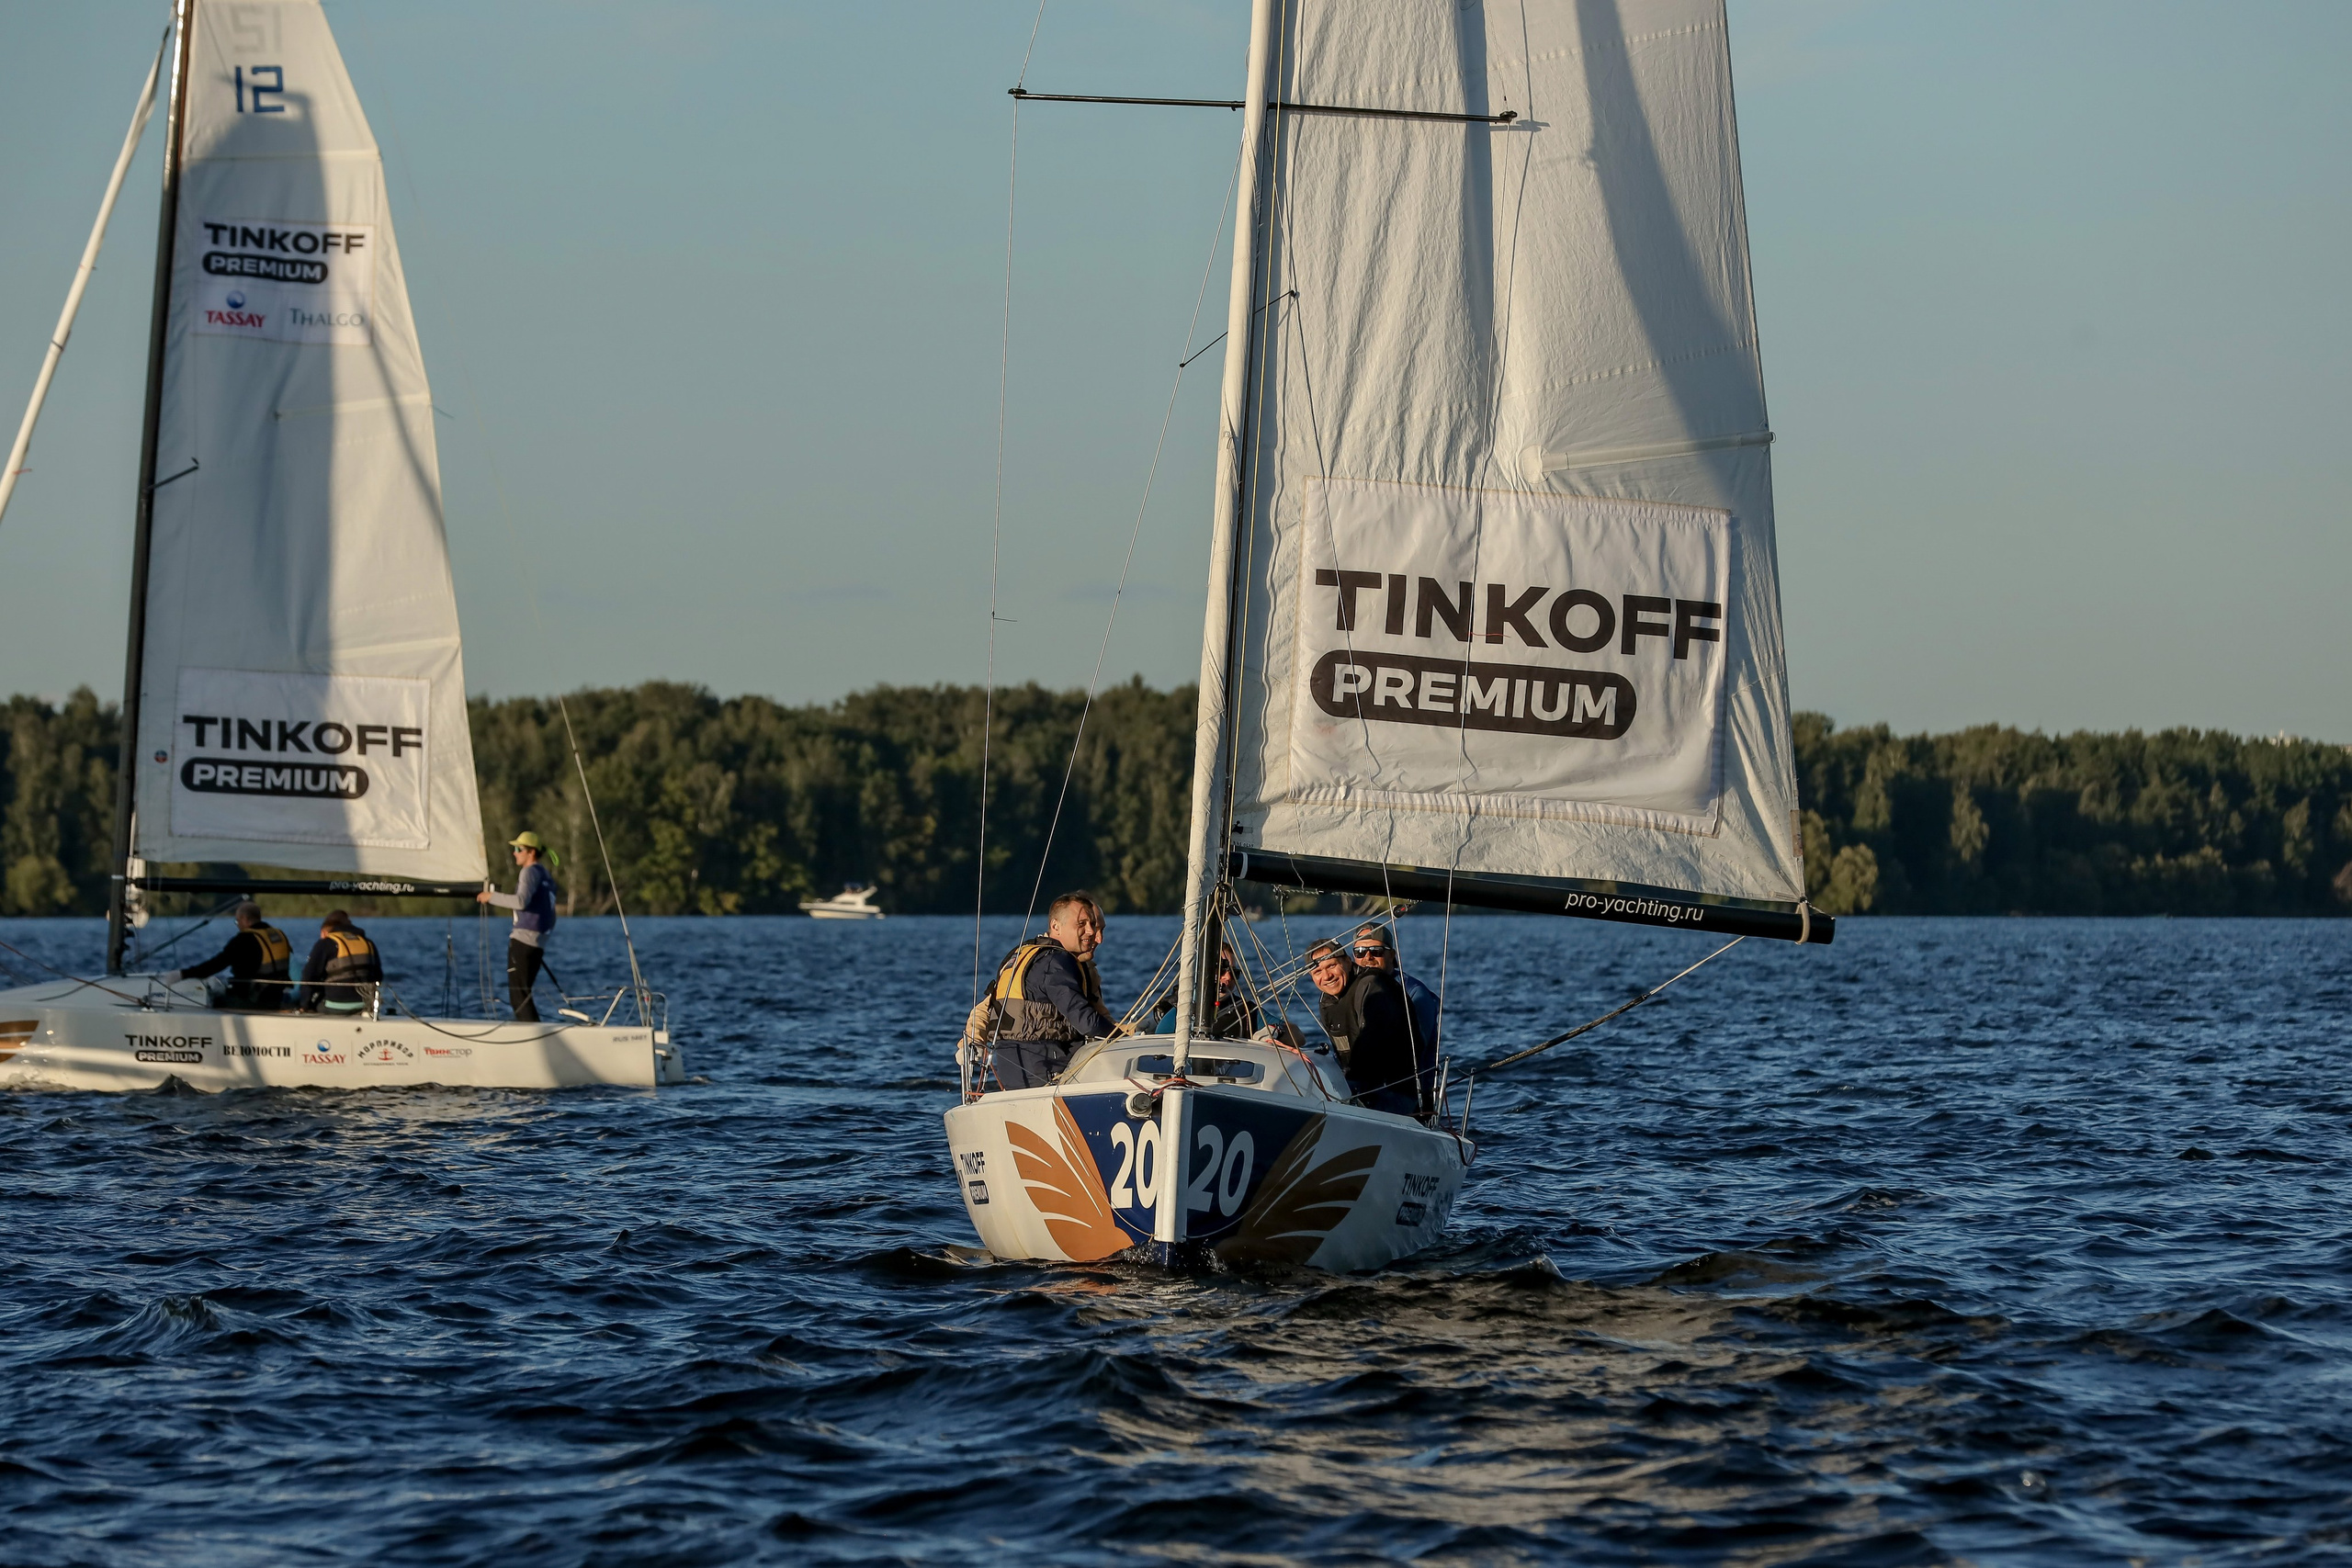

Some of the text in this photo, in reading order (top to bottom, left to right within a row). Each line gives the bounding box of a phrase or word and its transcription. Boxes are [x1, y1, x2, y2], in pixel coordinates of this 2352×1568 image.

[235, 65, 285, 113] 12
[203, 221, 366, 254] TINKOFF
[209, 256, 322, 280] PREMIUM
[205, 310, 266, 328] TASSAY
[1315, 568, 1723, 660] TINKOFF
[1331, 662, 1619, 727] PREMIUM
[183, 715, 423, 758] TINKOFF
[192, 763, 358, 794] PREMIUM
[329, 880, 415, 896] pro-yachting.ru
[1565, 891, 1704, 922] pro-yachting.ru
[125, 1034, 212, 1048] TINKOFF
[138, 1052, 199, 1062] PREMIUM
[301, 1053, 346, 1065] TASSAY
[1110, 1120, 1160, 1209] 20
[1187, 1124, 1254, 1217] 20
[1401, 1172, 1440, 1198] TINKOFF
